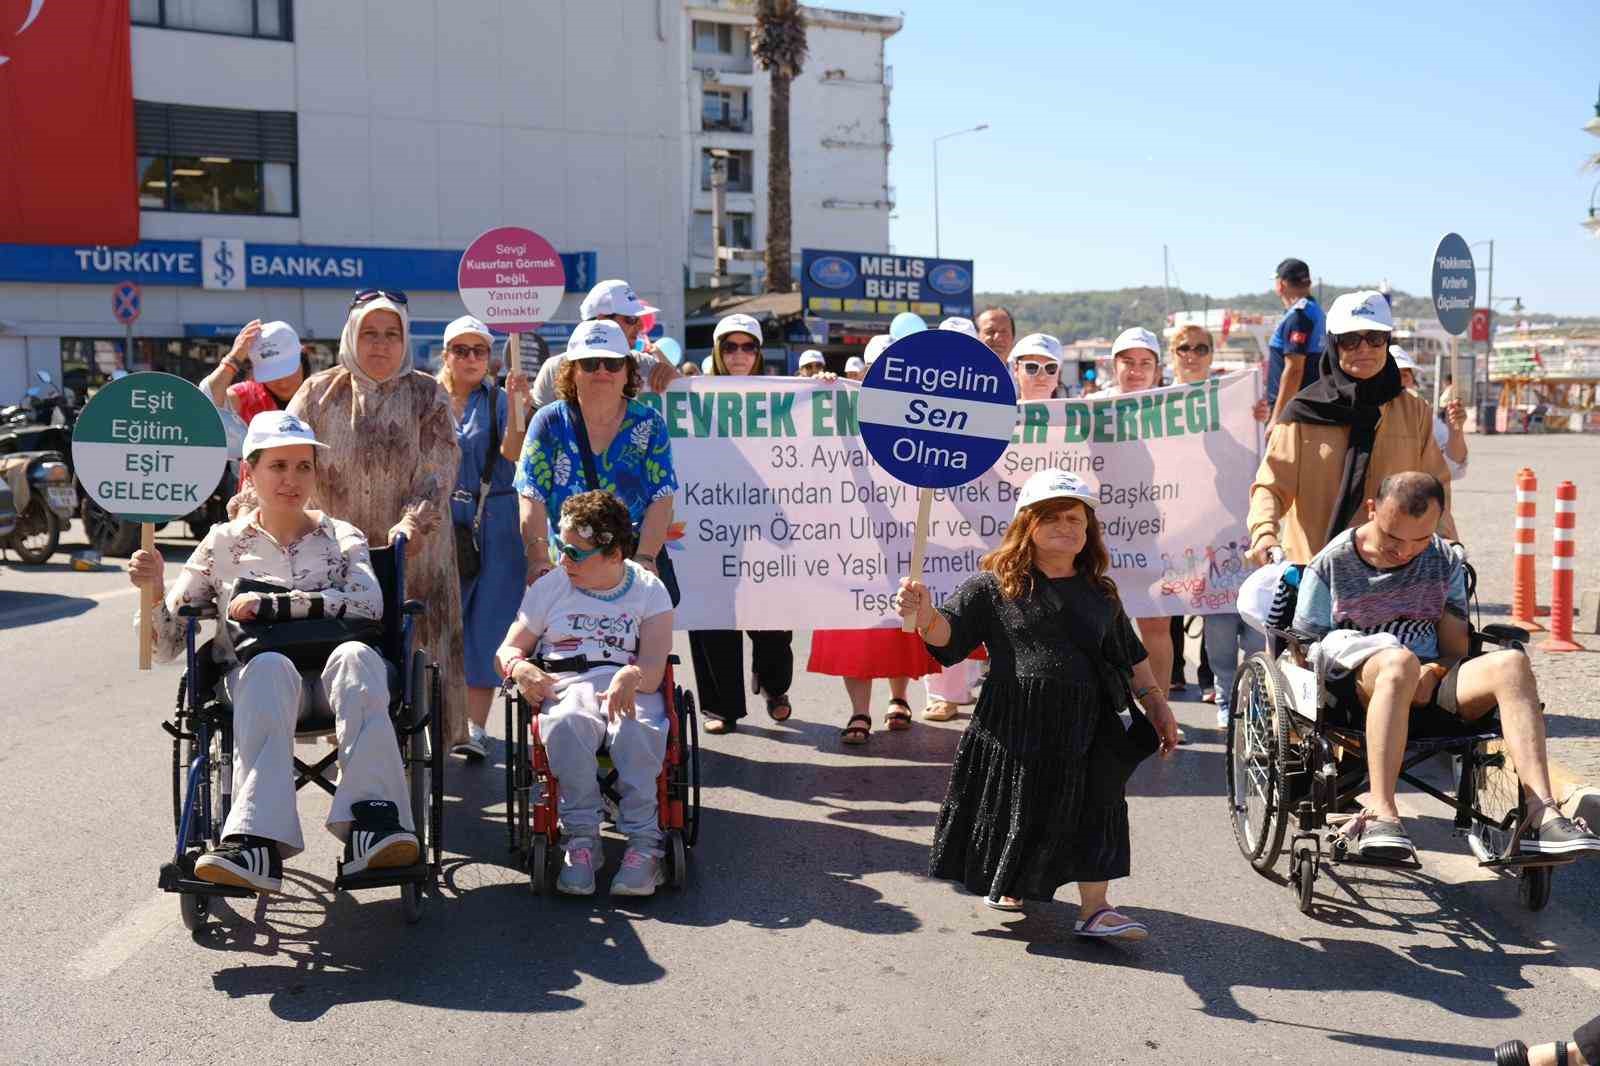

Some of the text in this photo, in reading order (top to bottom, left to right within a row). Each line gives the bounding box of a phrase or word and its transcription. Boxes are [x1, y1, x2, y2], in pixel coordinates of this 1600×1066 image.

[495, 243, 527, 256] Sevgi
[251, 256, 363, 278] BANKASI
[515, 258, 556, 269] Görmek
[487, 289, 538, 301] Yanında
[865, 279, 921, 300] BÜFE
[884, 356, 998, 394] Engelim
[131, 389, 175, 414] Eşit
[904, 399, 968, 430] Sen
[1064, 379, 1221, 443] DERNEĞİ
[111, 419, 190, 443] Eğitim,
[125, 450, 174, 477] EŞİT
[770, 445, 804, 468] 33.
[1003, 451, 1105, 476] Şenliğine
[892, 437, 968, 470] Olma
[98, 480, 198, 502] GELECEK
[685, 482, 832, 506] Katkılarından
[841, 480, 906, 508] Dolayı
[1099, 481, 1180, 508] Başkanı
[699, 518, 762, 547] Sayın
[770, 512, 841, 542] Özcan
[849, 516, 940, 544] Ulupınr
[946, 520, 972, 537] ve
[722, 555, 797, 583] Engelli
[804, 559, 830, 577] ve
[836, 553, 888, 581] Yaşlı
